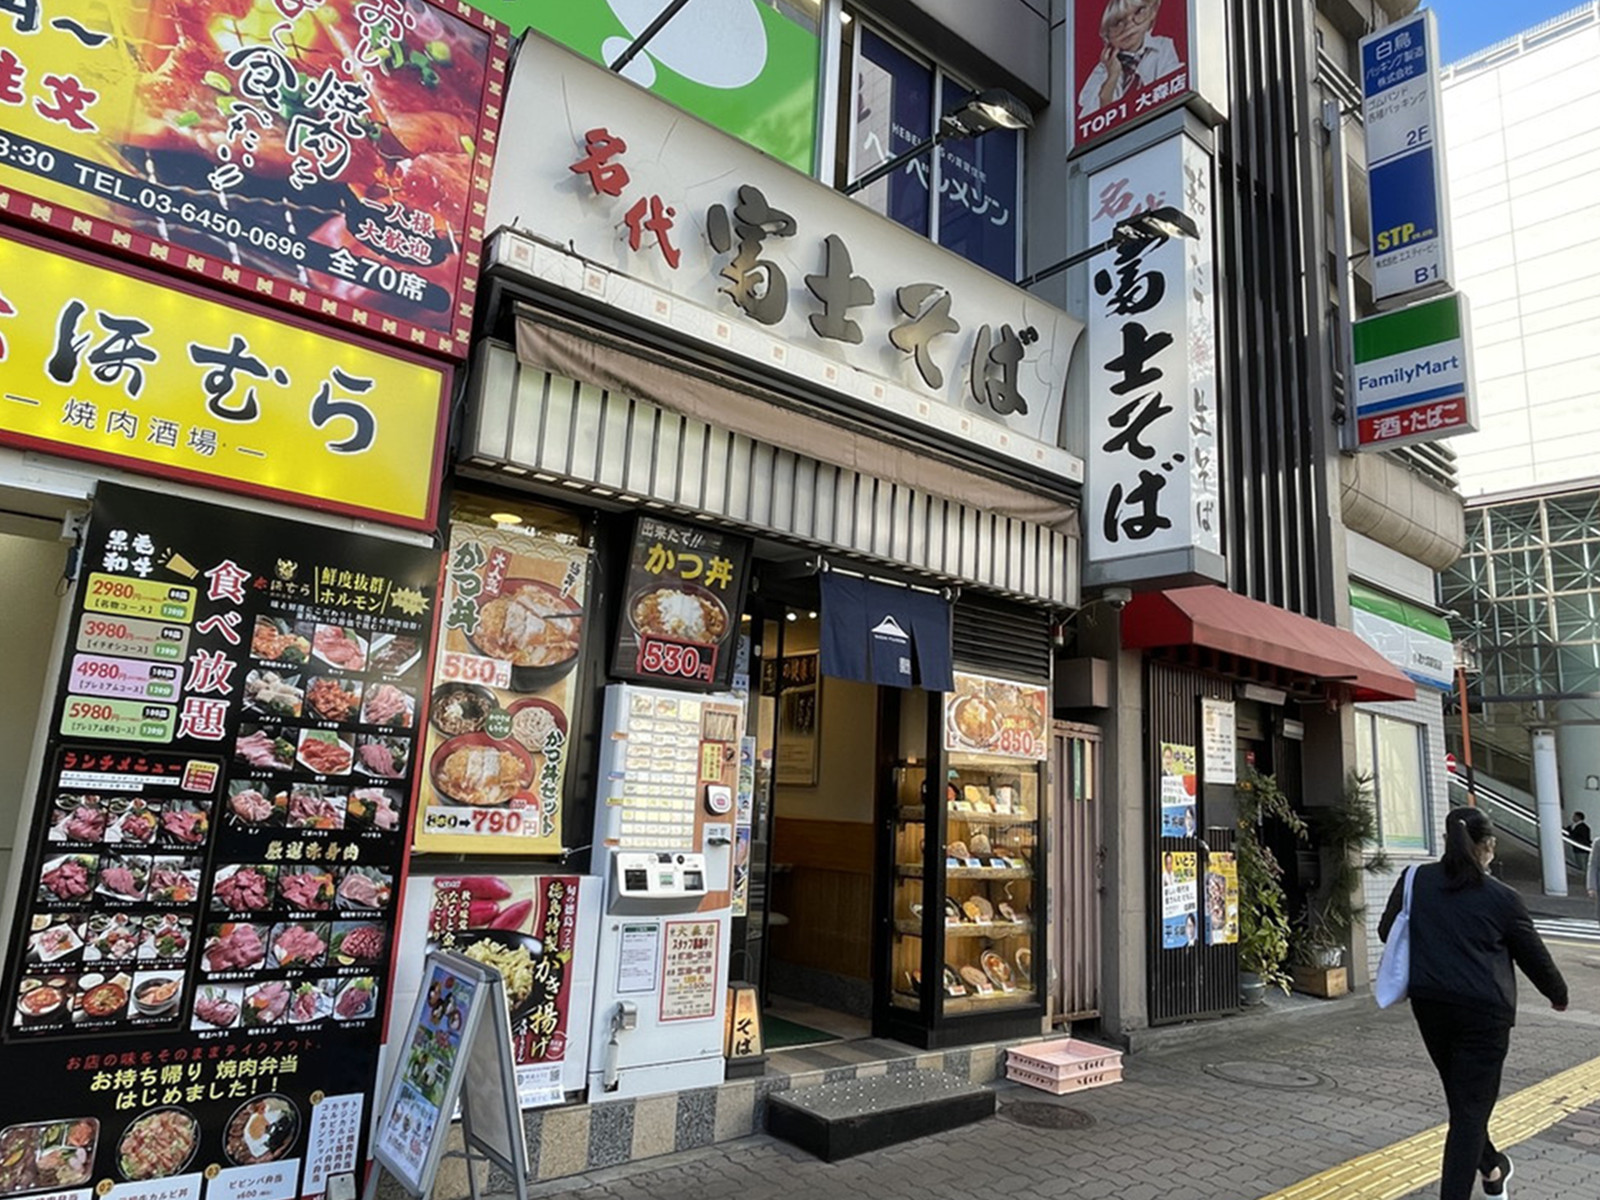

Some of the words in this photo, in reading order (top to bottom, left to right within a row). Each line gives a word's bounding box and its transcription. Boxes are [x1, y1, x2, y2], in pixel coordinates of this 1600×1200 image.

[1079, 104, 1127, 138] TOP1
[1135, 73, 1187, 112] 大森店
[891, 122, 921, 146] HEBE
[1406, 125, 1428, 146] 2F
[569, 128, 680, 269] 名代
[74, 162, 307, 260] TEL.03-6450-0696
[328, 248, 428, 302] 全70席
[355, 221, 432, 266] 大歓迎
[1377, 222, 1415, 251] STP
[1415, 264, 1438, 284] B1
[706, 184, 1040, 416] 富士そば
[1358, 356, 1459, 391] FamilyMart
[62, 397, 219, 458] 焼肉酒場
[1373, 403, 1460, 440] 酒・たばこ
[641, 522, 703, 548] 出来たて!!
[102, 551, 154, 578] 和牛
[320, 566, 385, 595] 鮮度抜群
[644, 543, 734, 589] かつ丼
[320, 590, 382, 612] ホルモン
[445, 541, 487, 636] かつ丼
[176, 559, 252, 741] 食べ放題
[643, 641, 711, 680] 530円
[63, 752, 182, 774] ランチメニュー
[540, 728, 563, 836] かつ丼セット
[1175, 854, 1195, 867] いとう
[531, 956, 561, 1059] かき揚げ
[736, 1018, 755, 1055] そば
[90, 1062, 203, 1091] お持ち帰り
[216, 1054, 298, 1080] 焼肉弁当
[115, 1076, 280, 1111] はじめました!!
